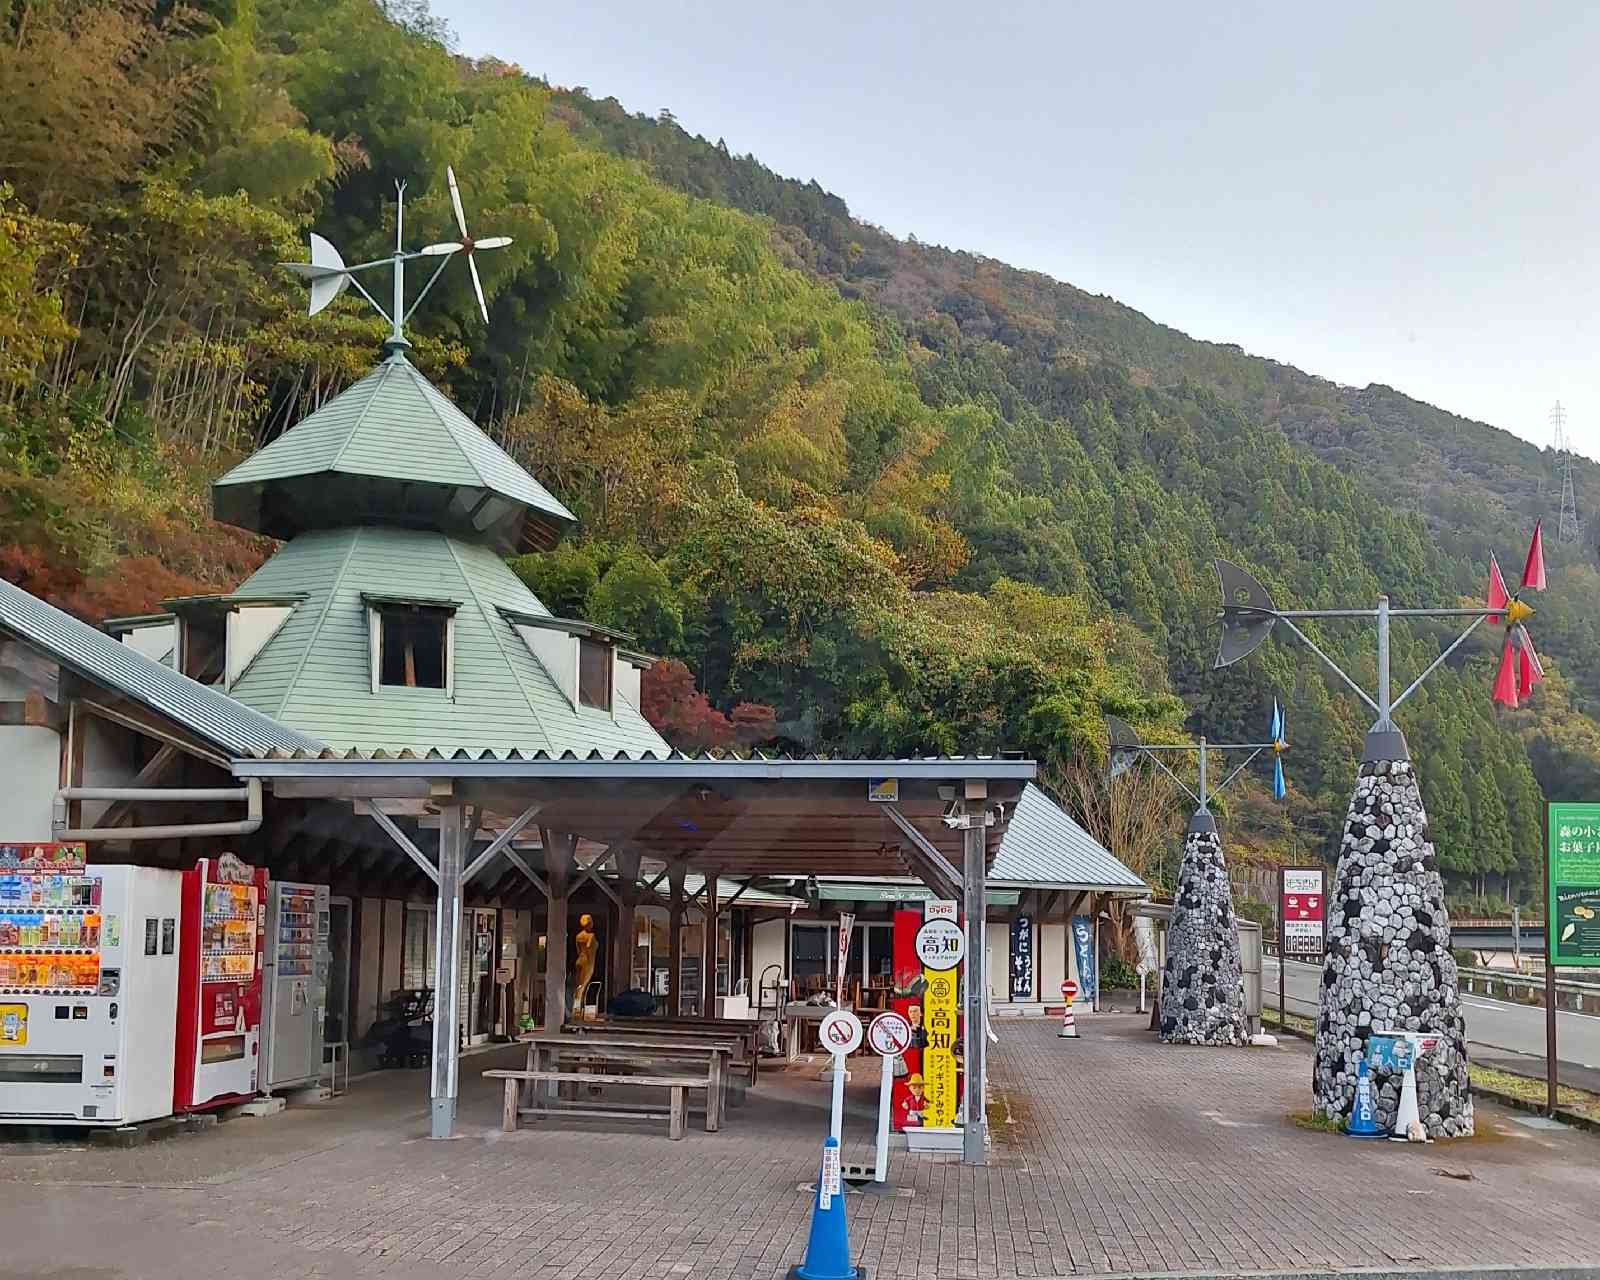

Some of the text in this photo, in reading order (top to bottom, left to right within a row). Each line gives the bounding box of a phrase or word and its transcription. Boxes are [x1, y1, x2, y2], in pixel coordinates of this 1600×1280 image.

[1559, 840, 1600, 854] お菓子
[929, 907, 953, 915] DyDo
[922, 936, 959, 954] 高知
[1019, 918, 1029, 953] つがに
[1013, 955, 1024, 992] そば
[1024, 955, 1033, 993] うどん
[931, 1008, 950, 1050] 高知
[935, 1054, 945, 1127] フィギュアみやげ
